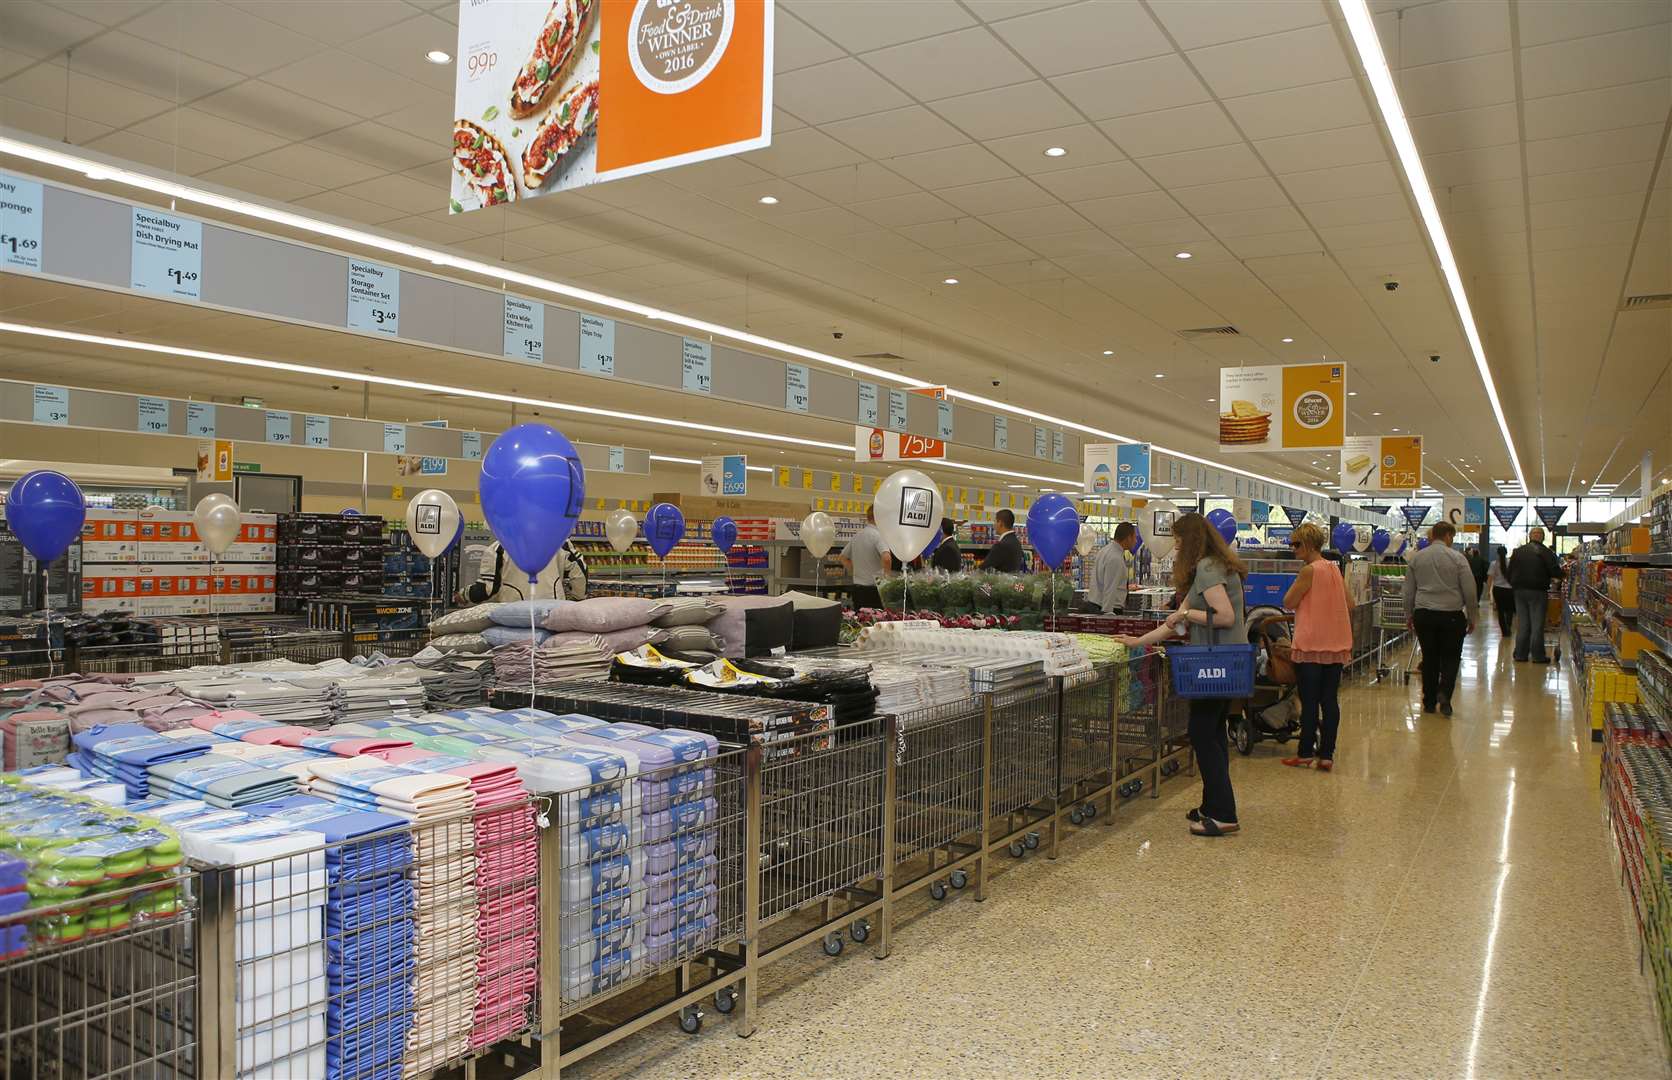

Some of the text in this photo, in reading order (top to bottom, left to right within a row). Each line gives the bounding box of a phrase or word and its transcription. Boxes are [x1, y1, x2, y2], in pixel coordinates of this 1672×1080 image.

[639, 3, 722, 45] Food & Drink
[647, 22, 712, 53] WINNER
[659, 43, 700, 60] OWN LABEL
[468, 52, 497, 78] 99p
[664, 53, 695, 74] 2016
[136, 213, 181, 231] Specialbuy
[0, 234, 38, 253] £1.69
[136, 230, 154, 241] Dish
[155, 234, 182, 248] Drying
[183, 241, 198, 250] Mat
[168, 268, 197, 285] £1.49
[351, 263, 384, 277] Specialbuy
[351, 278, 375, 289] Storage
[351, 286, 380, 298] Container
[380, 292, 391, 300] Set
[506, 299, 532, 311] Specialbuy
[372, 309, 396, 323] £3.49
[524, 340, 542, 352] £1.29
[1118, 475, 1146, 488] £1.69
[1384, 472, 1416, 486] £1.25
[907, 511, 926, 521] ALDI
[1197, 667, 1226, 679] ALDI
